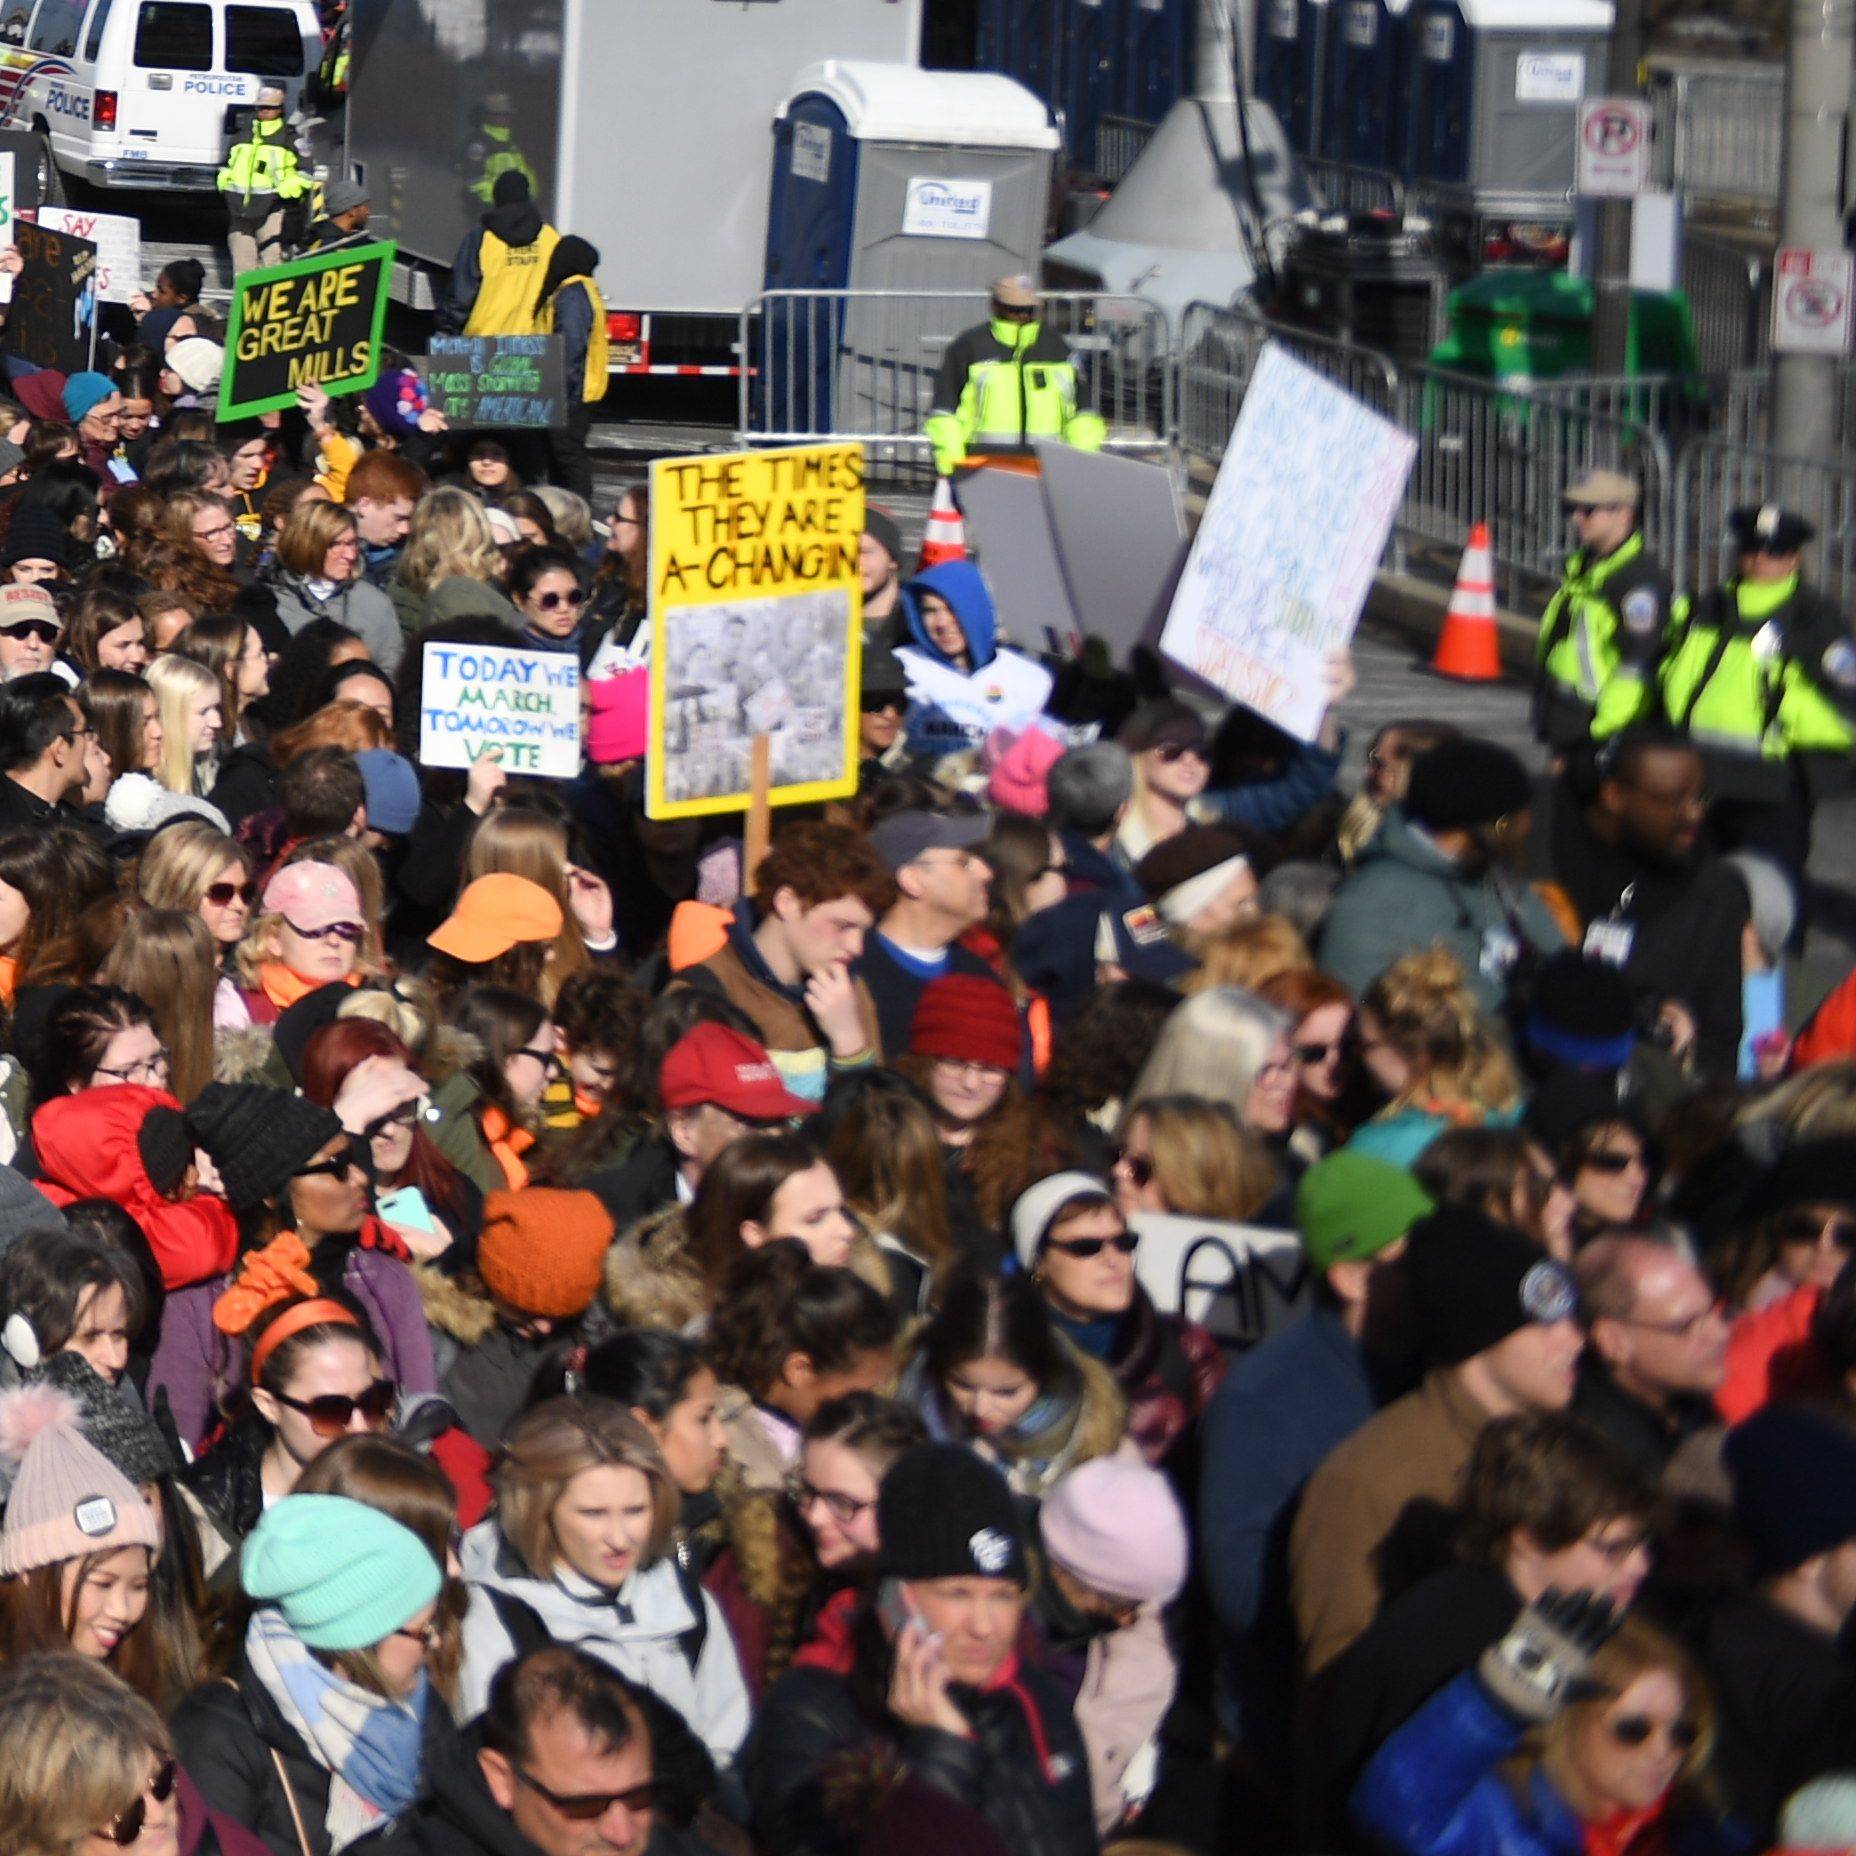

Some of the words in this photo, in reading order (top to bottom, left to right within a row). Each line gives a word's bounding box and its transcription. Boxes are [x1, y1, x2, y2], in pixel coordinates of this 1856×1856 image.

[46, 89, 89, 120] POLICE
[184, 81, 246, 95] POLICE
[244, 280, 294, 324] WE
[297, 265, 364, 313] ARE
[237, 309, 337, 362] GREAT
[287, 341, 370, 390] MILLS
[665, 460, 745, 501] THE
[762, 452, 863, 493] TIMES
[681, 501, 771, 545] THEY
[779, 498, 843, 534] ARE
[432, 650, 537, 682] TODAY
